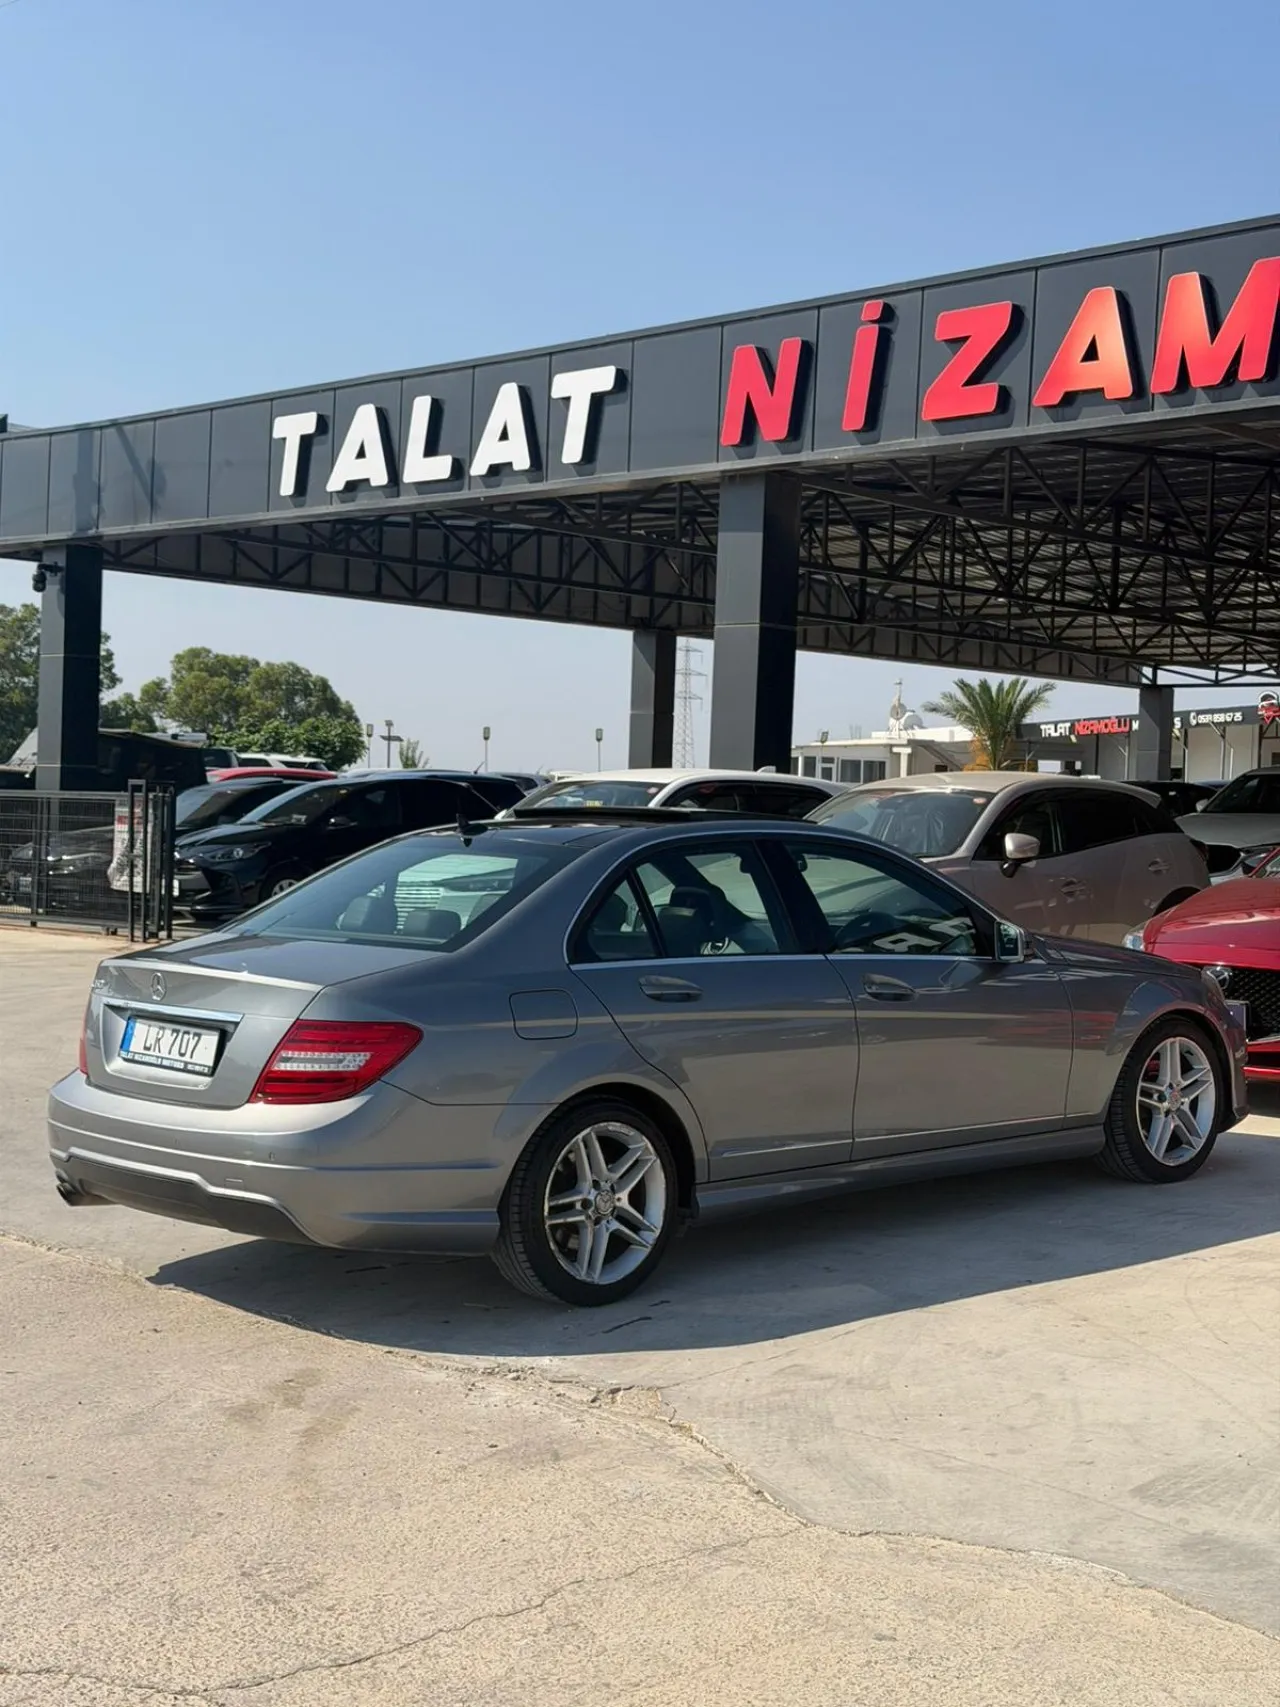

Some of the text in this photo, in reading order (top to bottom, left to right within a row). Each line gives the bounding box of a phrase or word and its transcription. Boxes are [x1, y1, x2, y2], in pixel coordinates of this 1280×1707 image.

[272, 256, 1280, 497] TALAT NİZAM
[1040, 722, 1071, 737] TALAT
[1073, 716, 1130, 735] NİZAMOĞLU
[143, 1024, 202, 1059] LR 707
